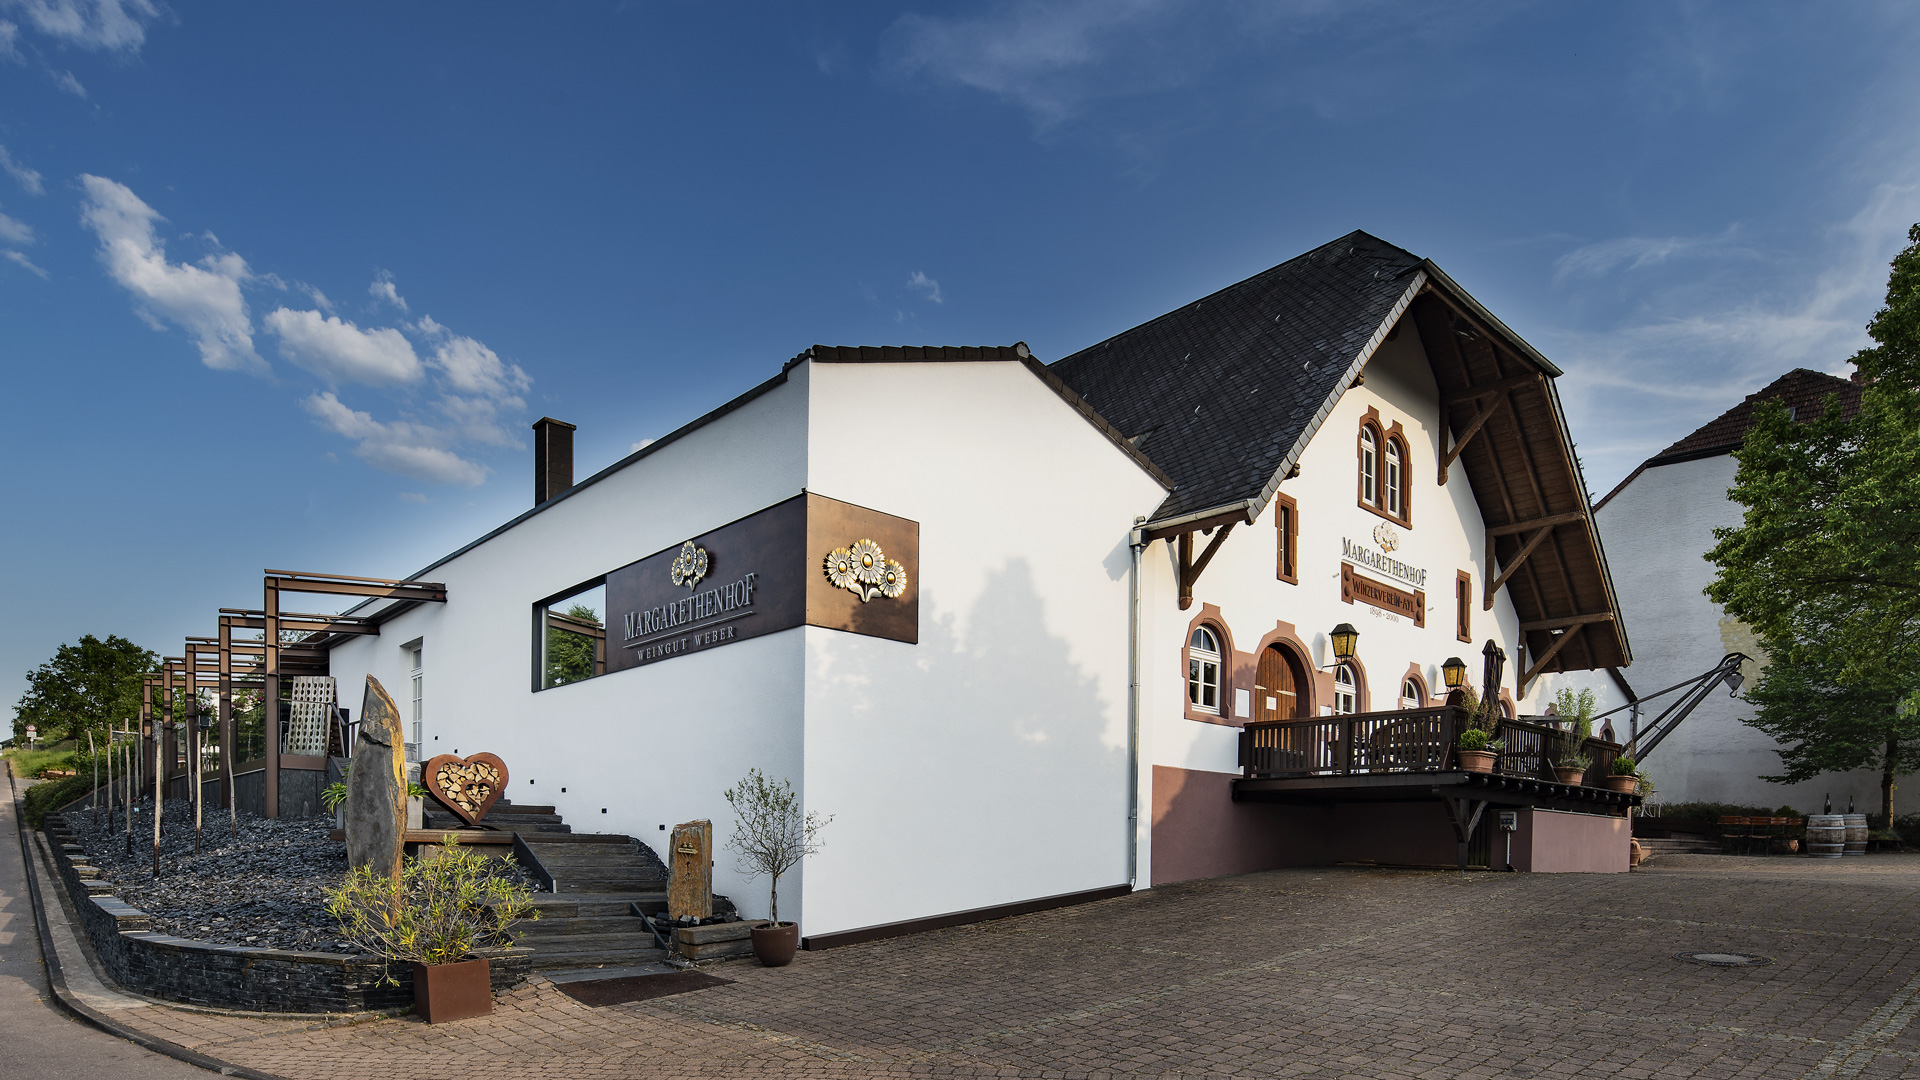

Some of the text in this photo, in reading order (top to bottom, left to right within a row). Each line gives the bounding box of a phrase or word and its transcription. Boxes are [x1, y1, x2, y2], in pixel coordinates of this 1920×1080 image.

[1342, 537, 1427, 586] MARGARETHENHOF
[623, 572, 755, 641] MARGARETHENHOF
[637, 625, 734, 661] WEINGUT WEBER
